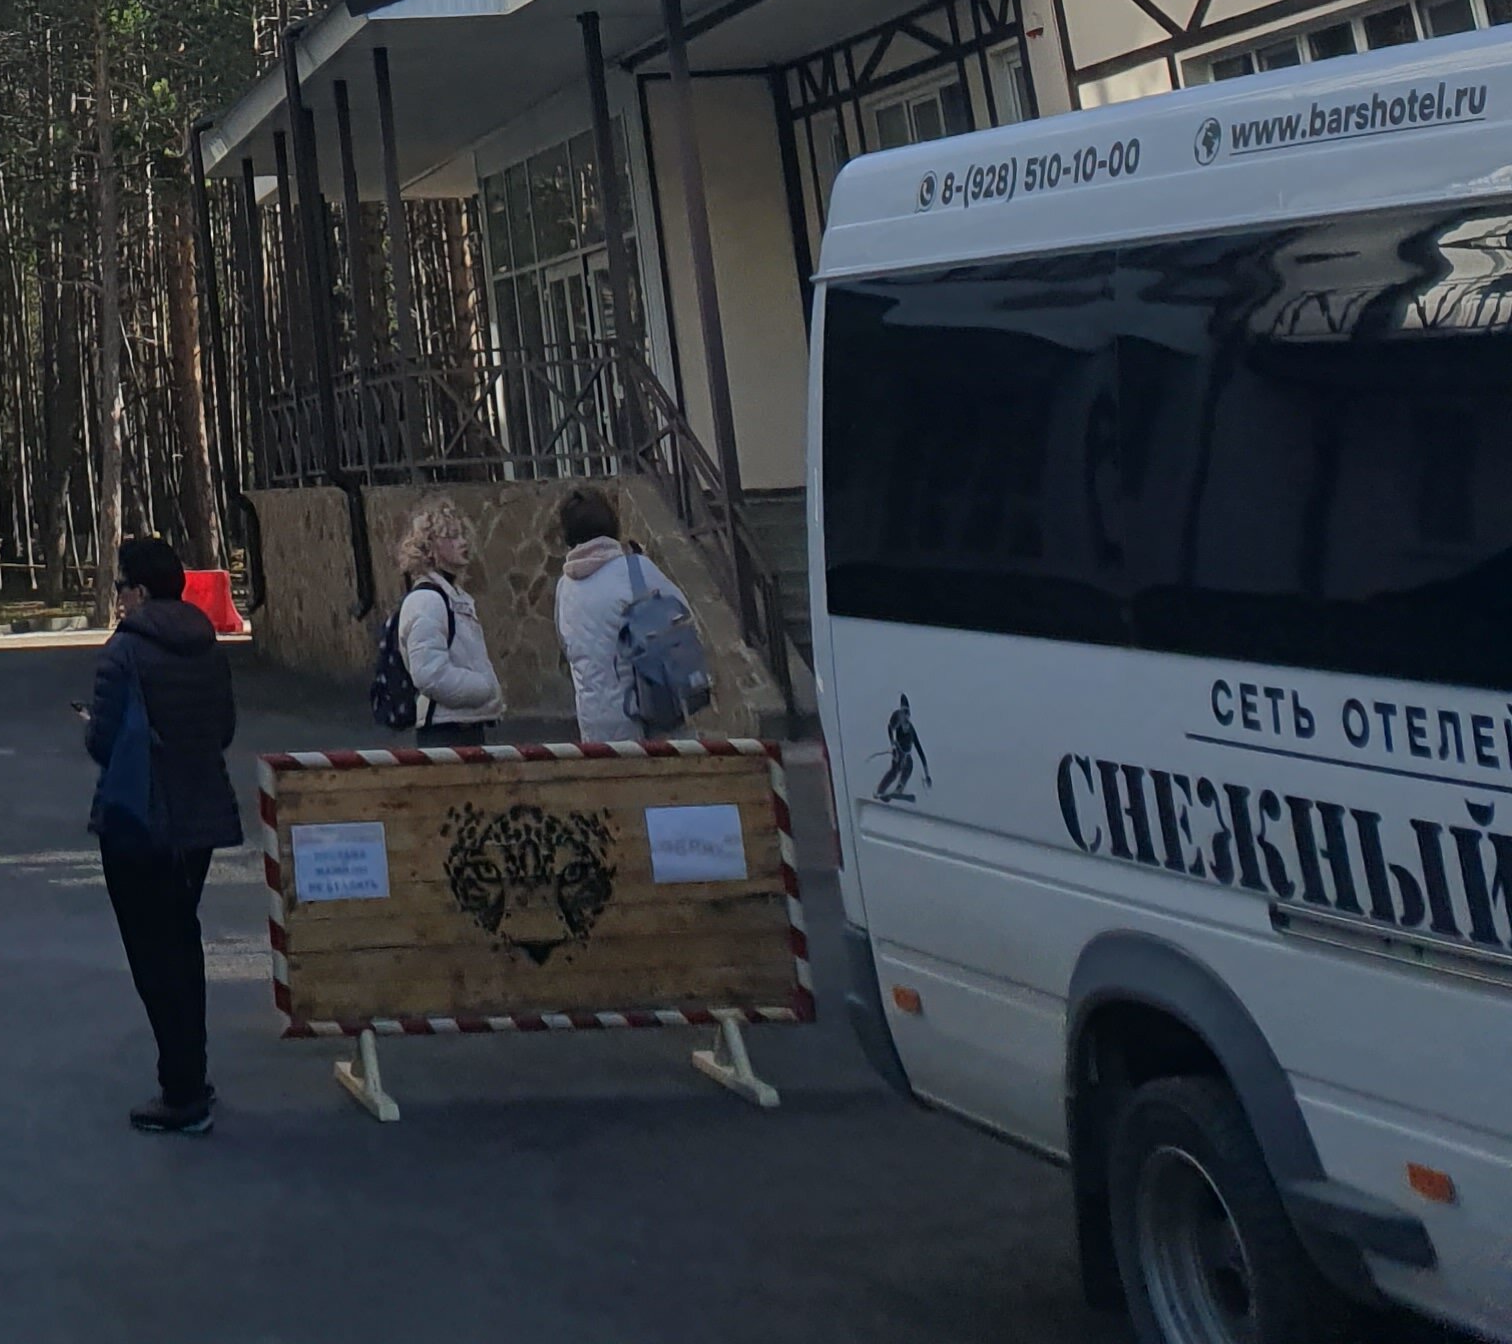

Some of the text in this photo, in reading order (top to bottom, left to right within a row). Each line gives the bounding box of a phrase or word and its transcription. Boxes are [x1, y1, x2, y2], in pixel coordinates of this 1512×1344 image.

[1229, 81, 1487, 150] www.barshotel.ru
[941, 138, 1141, 208] 8-(928) 510-10-00
[1210, 678, 1512, 771] СЕТЬ ОТЕЛЕ
[1056, 752, 1512, 951] СНЕЖНЫЙ
